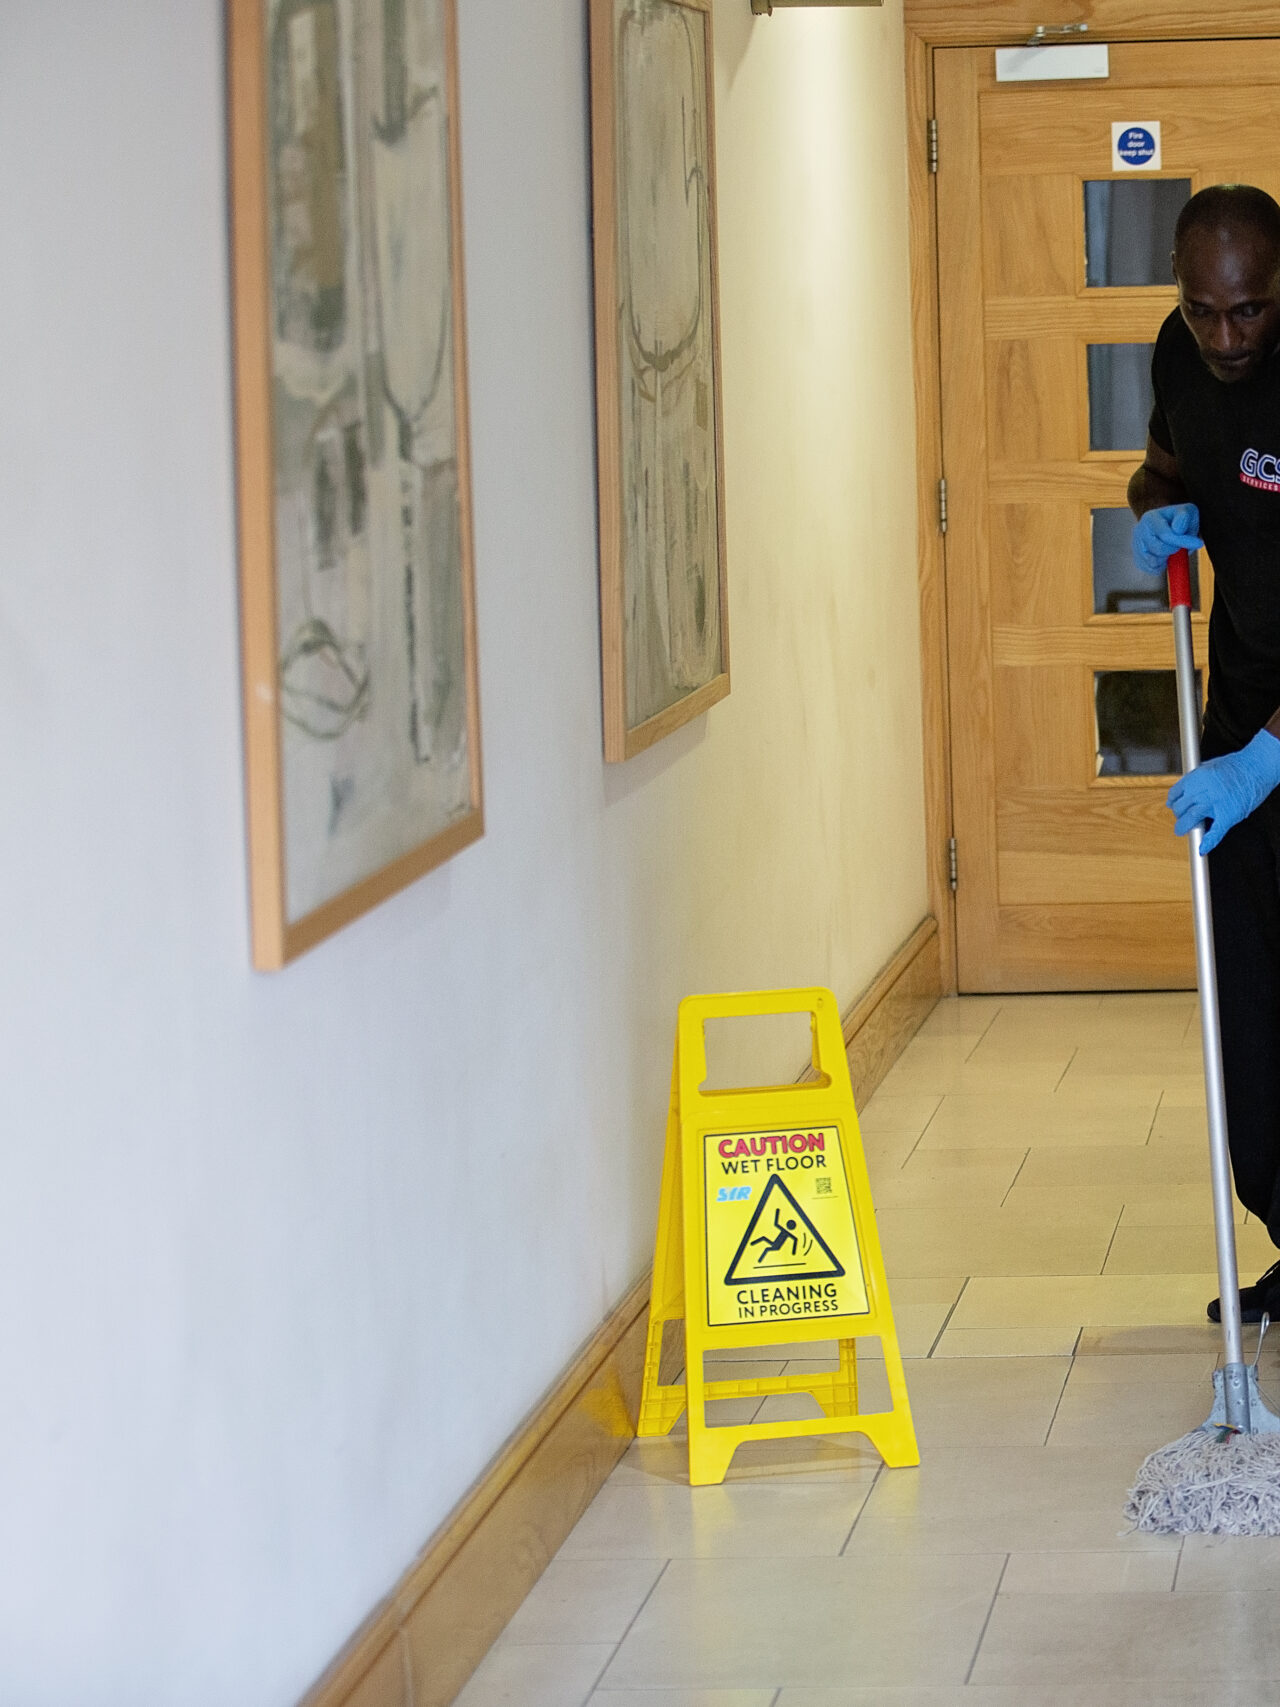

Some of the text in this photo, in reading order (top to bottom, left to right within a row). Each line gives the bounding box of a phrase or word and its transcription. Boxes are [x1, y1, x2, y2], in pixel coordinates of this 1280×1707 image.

[1128, 131, 1144, 140] Fire
[718, 1132, 826, 1158] CAUTION
[721, 1155, 827, 1174] WET FLOOR
[716, 1186, 752, 1202] SIR
[736, 1283, 838, 1305] CLEANING
[738, 1299, 839, 1318] IN PROGRESS
